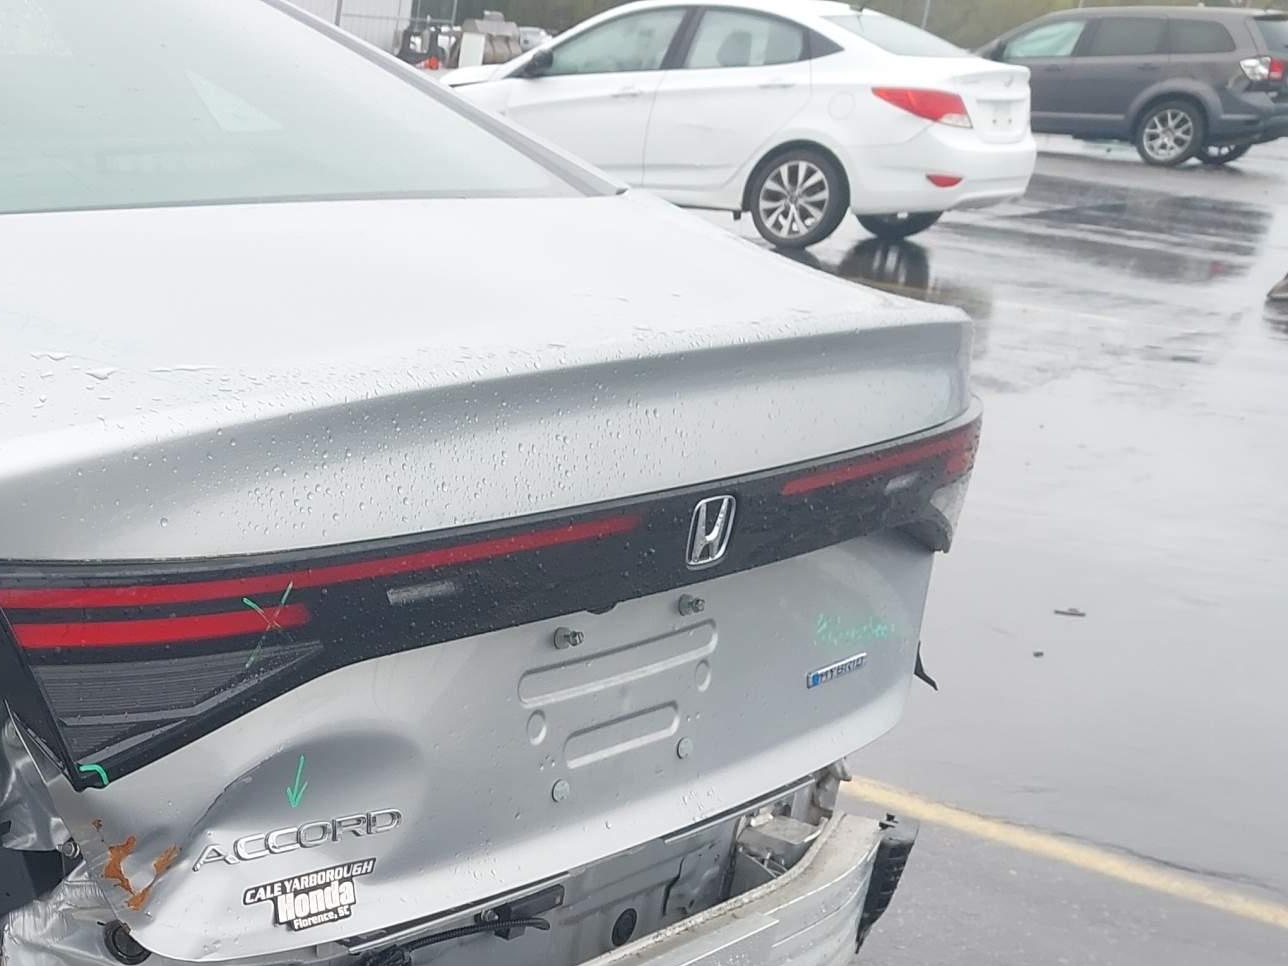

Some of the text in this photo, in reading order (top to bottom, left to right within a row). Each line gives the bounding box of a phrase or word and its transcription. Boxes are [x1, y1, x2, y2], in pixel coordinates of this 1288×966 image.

[192, 808, 403, 872] ACCORD
[244, 859, 374, 904] CALE YARBOROUGH
[277, 879, 355, 923] Honda
[293, 905, 350, 930] Florence, SC
